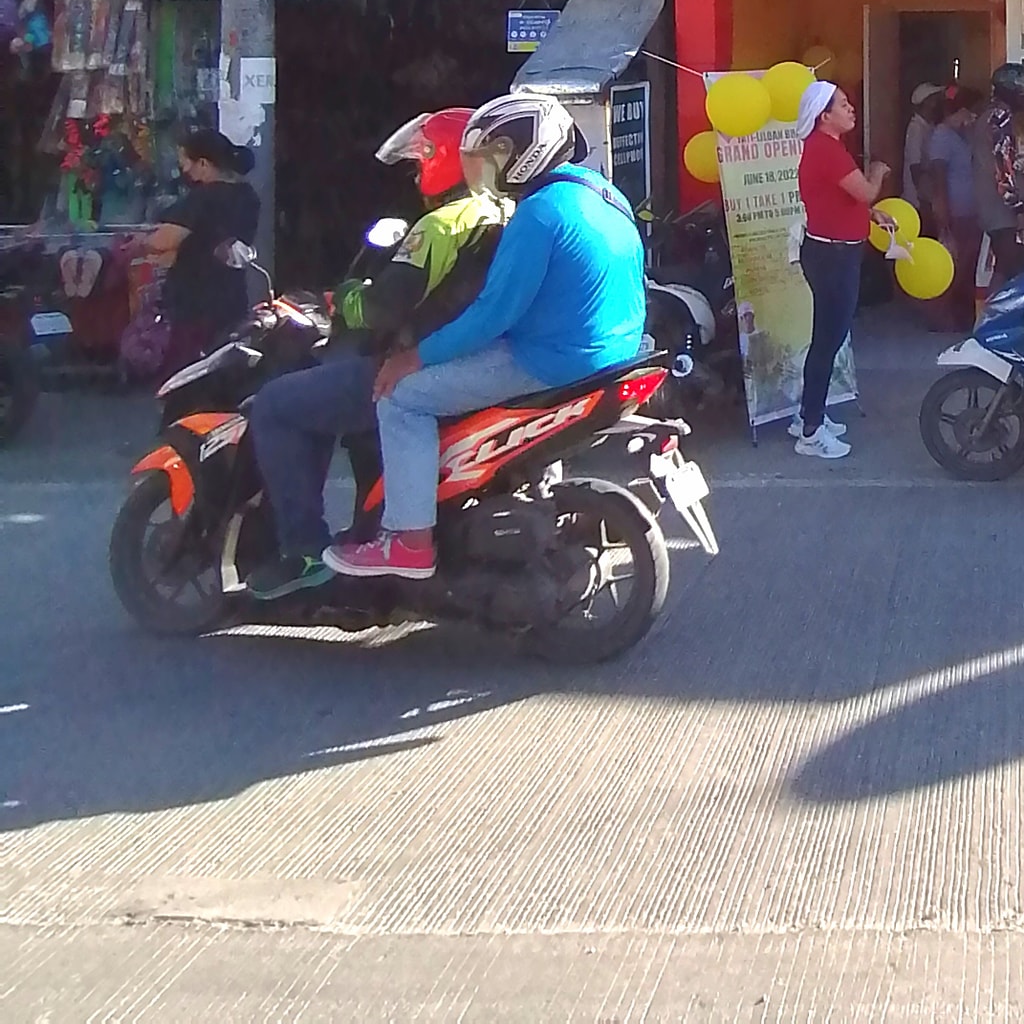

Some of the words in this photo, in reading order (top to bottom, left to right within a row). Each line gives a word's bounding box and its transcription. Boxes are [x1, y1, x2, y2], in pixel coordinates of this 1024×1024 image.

[613, 103, 626, 124] WE
[511, 143, 547, 182] HONDA
[716, 143, 760, 164] GRAND
[744, 172, 763, 186] JUNE
[724, 197, 742, 212] BUY
[753, 193, 778, 209] TAKE
